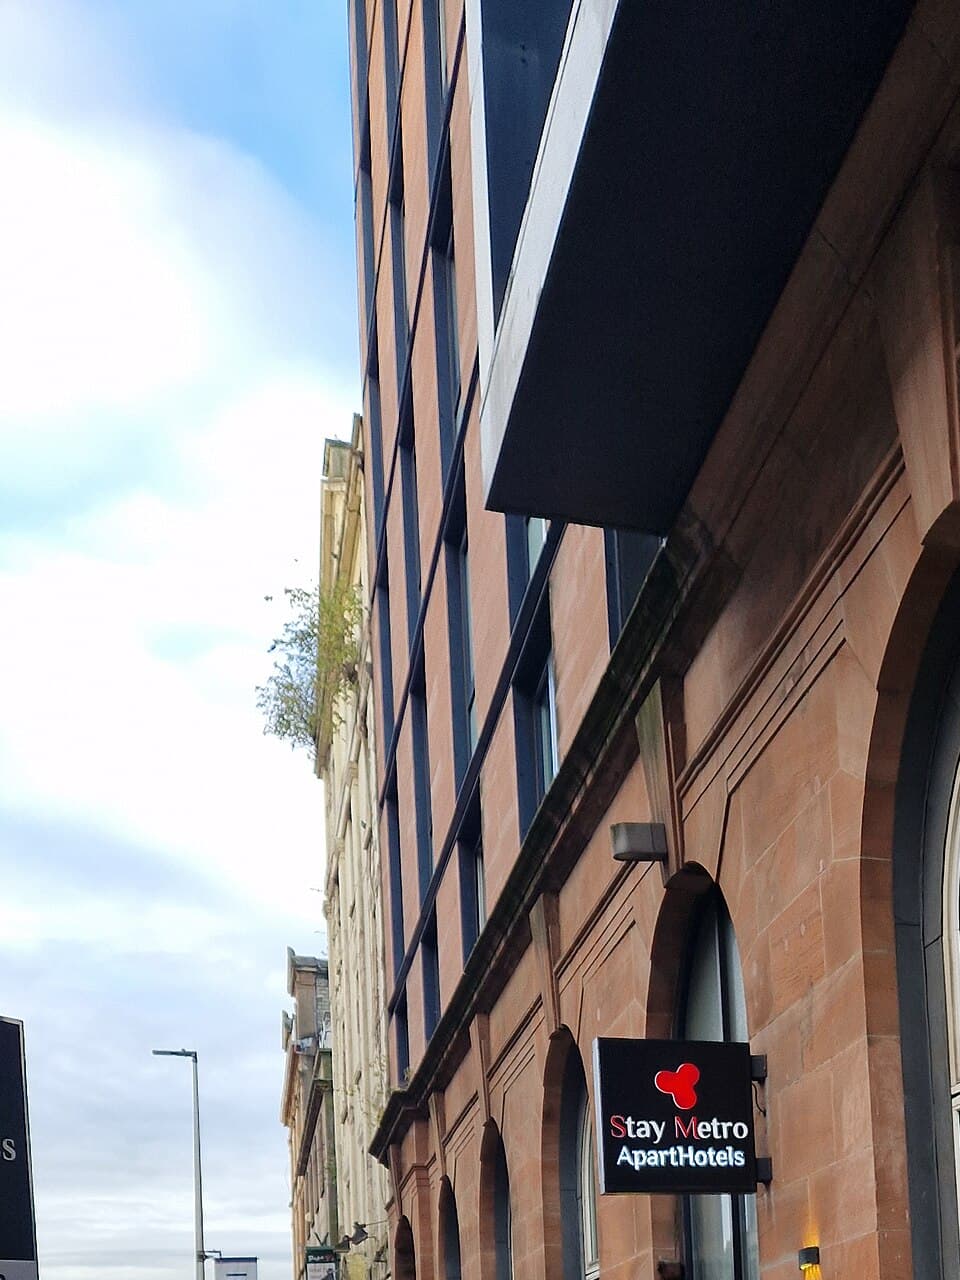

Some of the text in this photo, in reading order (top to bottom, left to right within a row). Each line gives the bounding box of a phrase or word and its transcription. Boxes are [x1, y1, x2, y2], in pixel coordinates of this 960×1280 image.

[610, 1115, 748, 1144] Stay Metro
[617, 1146, 745, 1171] ApartHotels
